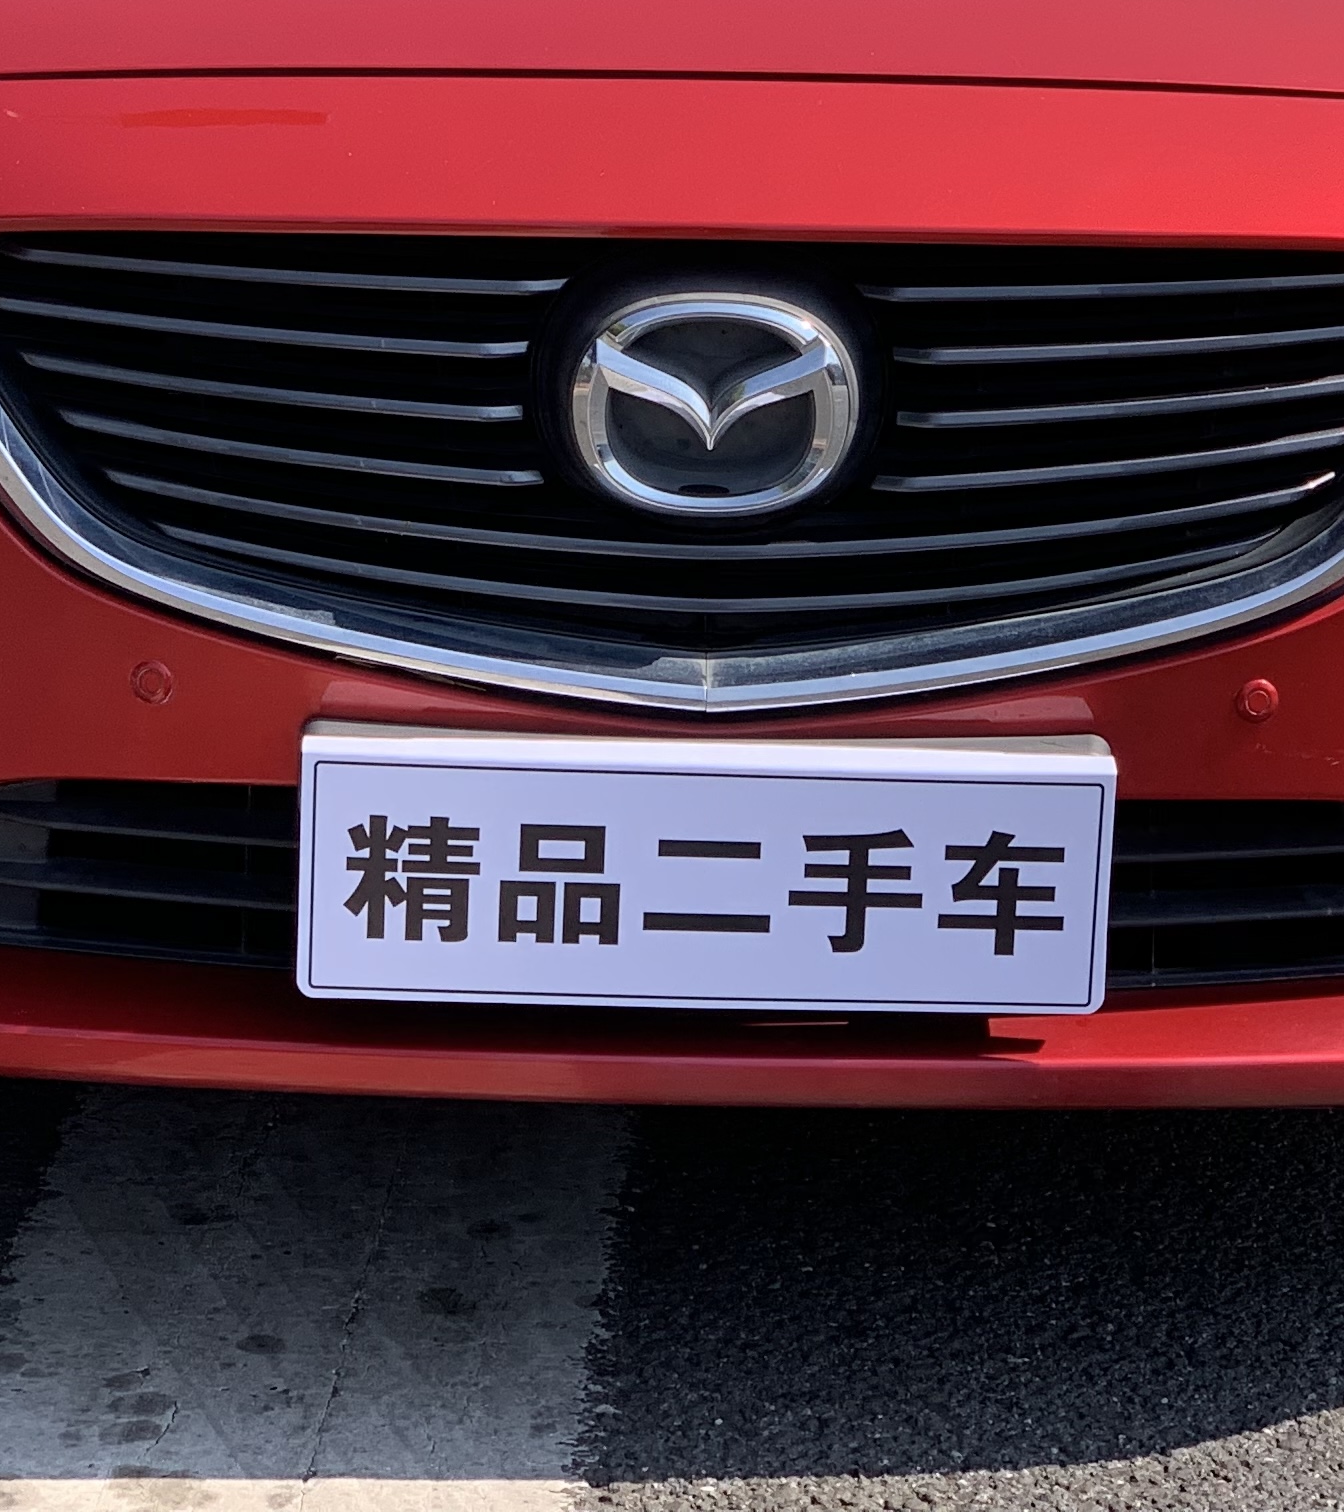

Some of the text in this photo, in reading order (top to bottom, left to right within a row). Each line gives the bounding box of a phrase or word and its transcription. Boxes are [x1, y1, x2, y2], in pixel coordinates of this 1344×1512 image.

[343, 814, 1066, 956] 精品二手车
